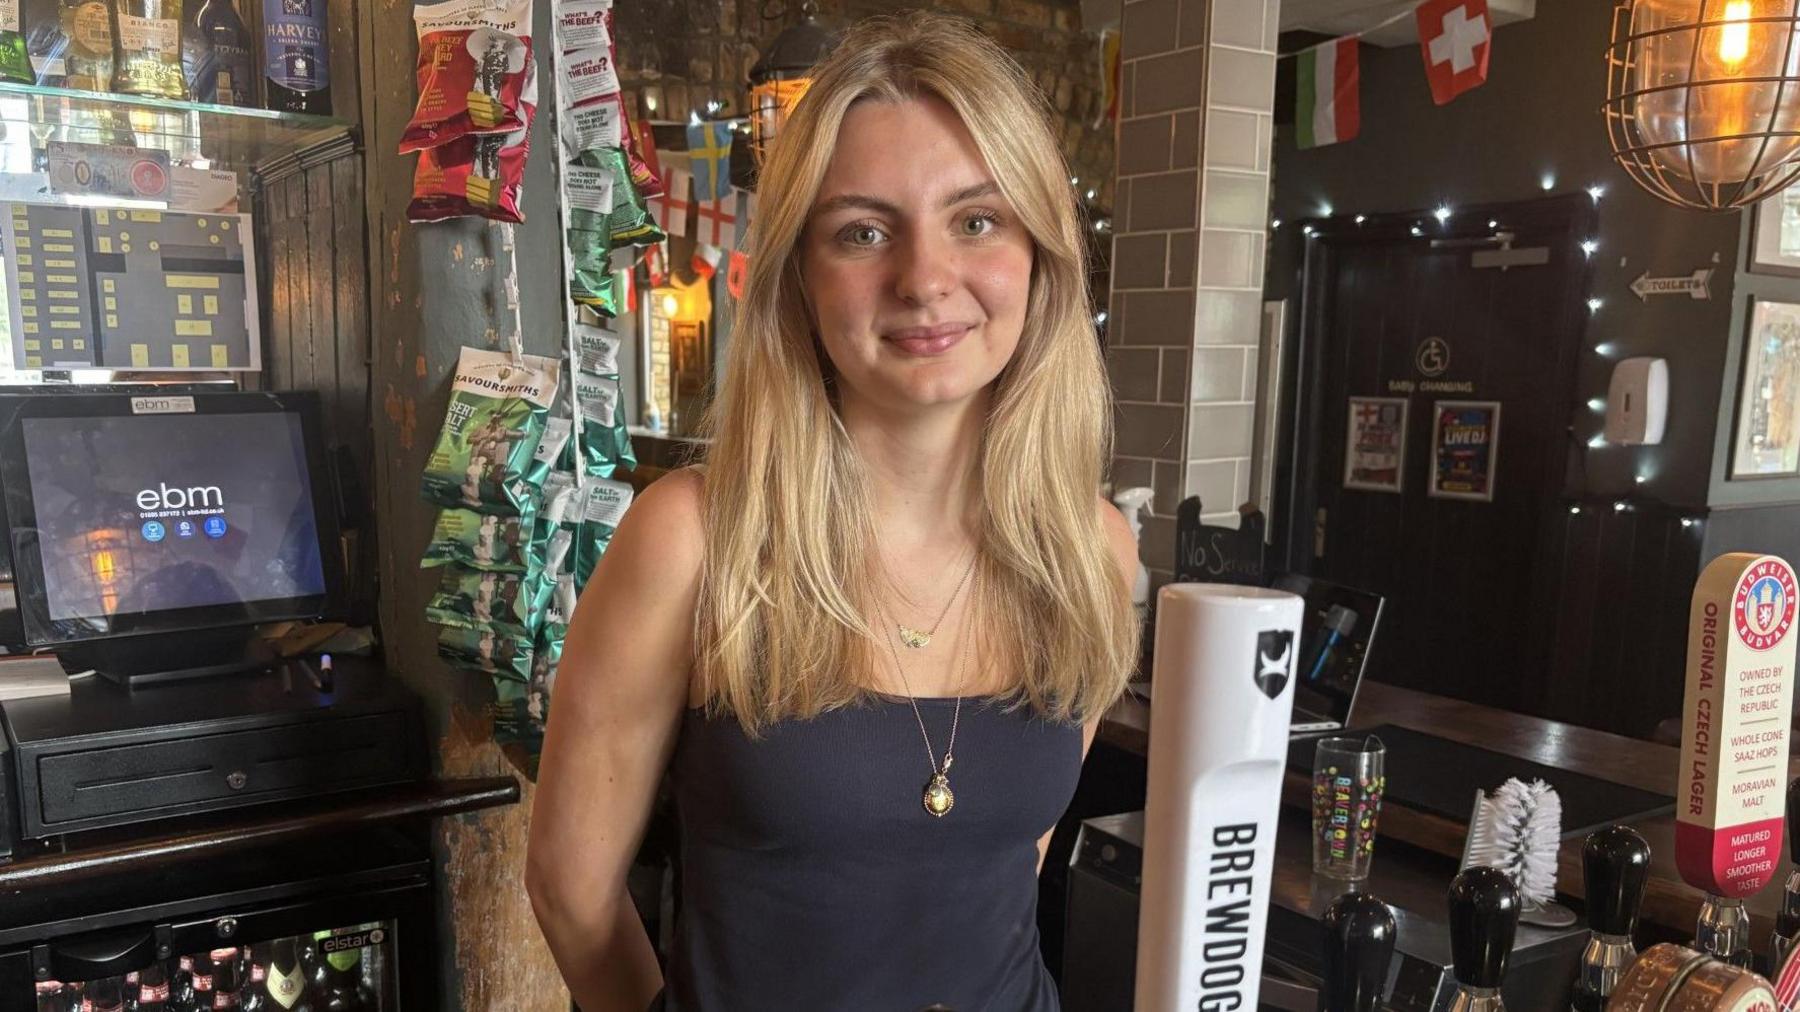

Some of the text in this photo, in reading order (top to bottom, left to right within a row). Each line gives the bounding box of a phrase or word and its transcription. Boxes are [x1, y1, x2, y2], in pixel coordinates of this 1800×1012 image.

[130, 20, 168, 29] BIANCO
[422, 19, 516, 31] SAVOURSMITHS
[561, 11, 602, 27] THE BEEF?
[568, 57, 607, 79] THE BEEF?
[1651, 278, 1702, 291] TOILETS
[454, 374, 540, 397] SAVOURSMITHS
[1419, 381, 1473, 393] CHANGING
[135, 399, 170, 409] ebm
[1445, 431, 1487, 445] LIVE DJ
[136, 482, 224, 510] ebm
[1180, 530, 1206, 567] No
[1735, 562, 1795, 610] BUDWEISER
[1740, 620, 1789, 648] BUDVAR
[1698, 602, 1718, 692] ORIGINAL
[1739, 666, 1784, 682] OWNED BY
[1740, 682, 1782, 698] THE CZECH
[1740, 698, 1779, 714] REPUBLIC
[1694, 698, 1711, 756] CZECH
[1731, 729, 1785, 747] WHOLE CONE
[1734, 746, 1778, 763] SAAZ HOPS
[1689, 760, 1708, 816] LAGER
[1732, 778, 1777, 795] MORAVIAN
[1742, 795, 1765, 808] MALT
[1330, 776, 1352, 859] BEAVERTOWN
[1731, 829, 1771, 847] MATURED
[1733, 846, 1766, 862] LONGER
[1726, 860, 1772, 879] SMOOTHER
[1737, 877, 1760, 891] TASTE
[1198, 822, 1258, 1012] BREWDOG
[323, 934, 369, 952] elstar
